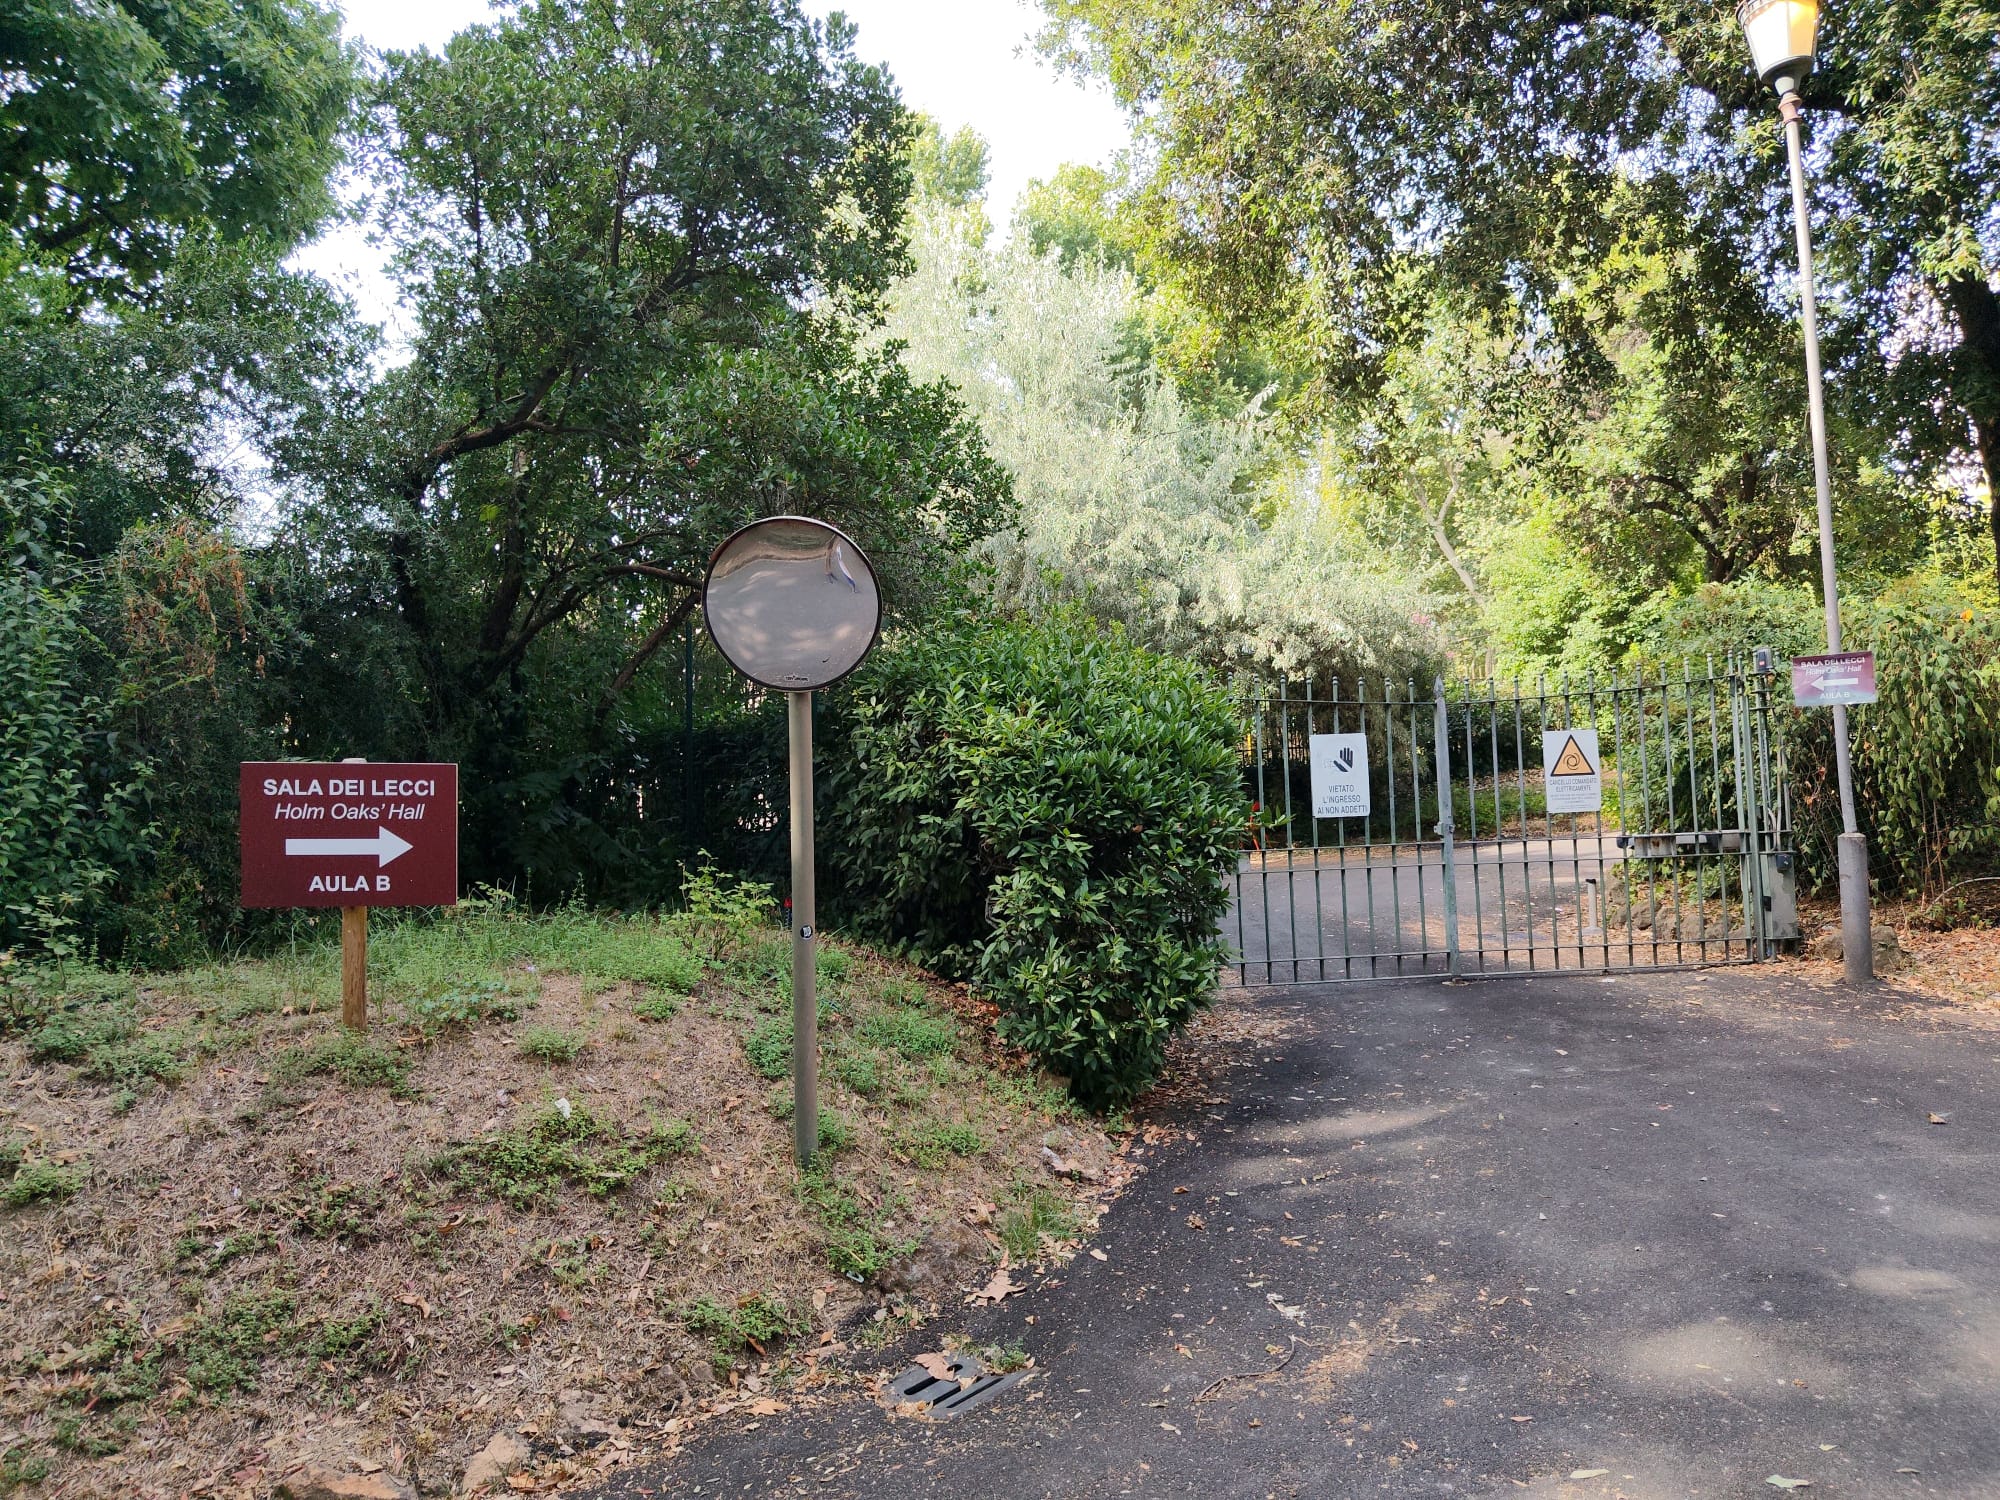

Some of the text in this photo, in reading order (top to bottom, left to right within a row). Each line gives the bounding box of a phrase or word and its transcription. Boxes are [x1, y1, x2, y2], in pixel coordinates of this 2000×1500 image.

[1840, 657, 1865, 665] LECCI
[1820, 692, 1842, 700] AULA
[263, 779, 435, 797] SALA DEI LECCI
[1328, 784, 1355, 793] VIETATO
[1323, 795, 1360, 804] L'INGRESSO
[274, 803, 425, 820] Holm Oaks' Hall
[1317, 804, 1368, 815] AI NON ADDETTI
[309, 875, 391, 892] AULA B
